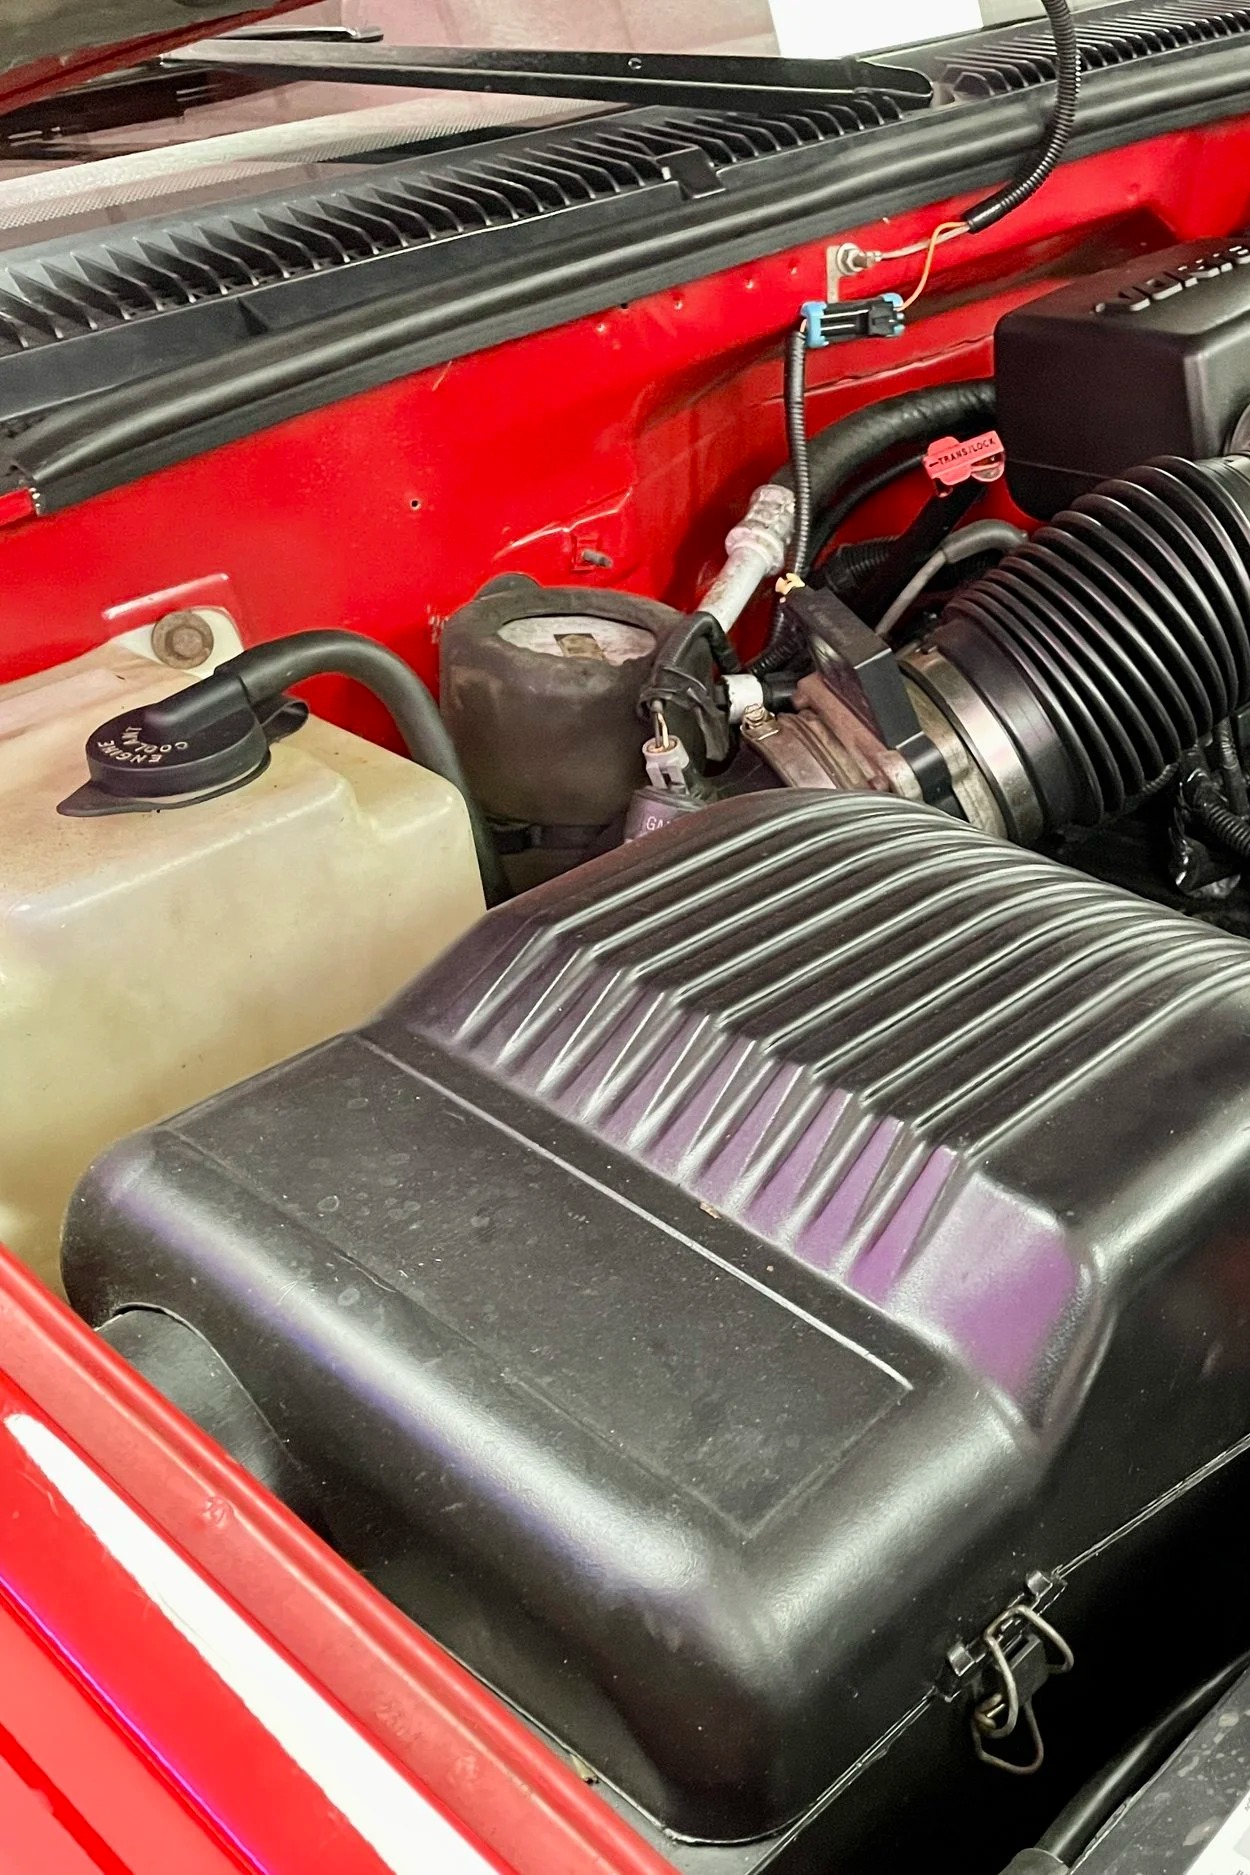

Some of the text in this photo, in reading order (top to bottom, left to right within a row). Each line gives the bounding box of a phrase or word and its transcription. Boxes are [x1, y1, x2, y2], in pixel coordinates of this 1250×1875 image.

[938, 437, 997, 466] TRANS/LOCK
[97, 740, 163, 764] ENGINE
[121, 726, 189, 754] COOLANT
